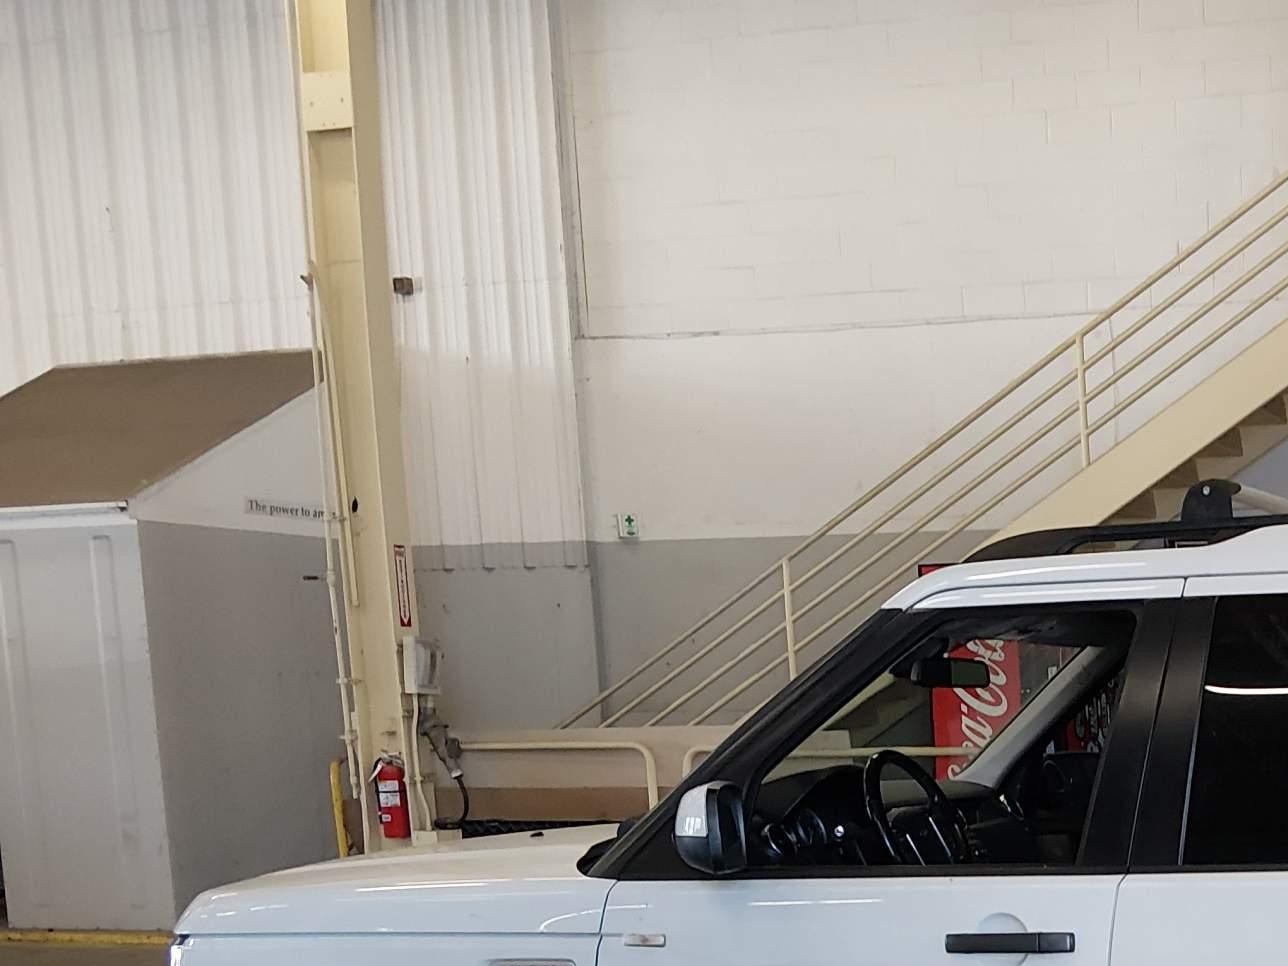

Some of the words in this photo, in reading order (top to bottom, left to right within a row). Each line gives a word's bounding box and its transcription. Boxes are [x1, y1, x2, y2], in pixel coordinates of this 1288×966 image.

[248, 499, 267, 513] The
[269, 504, 299, 516] power
[301, 507, 310, 517] to
